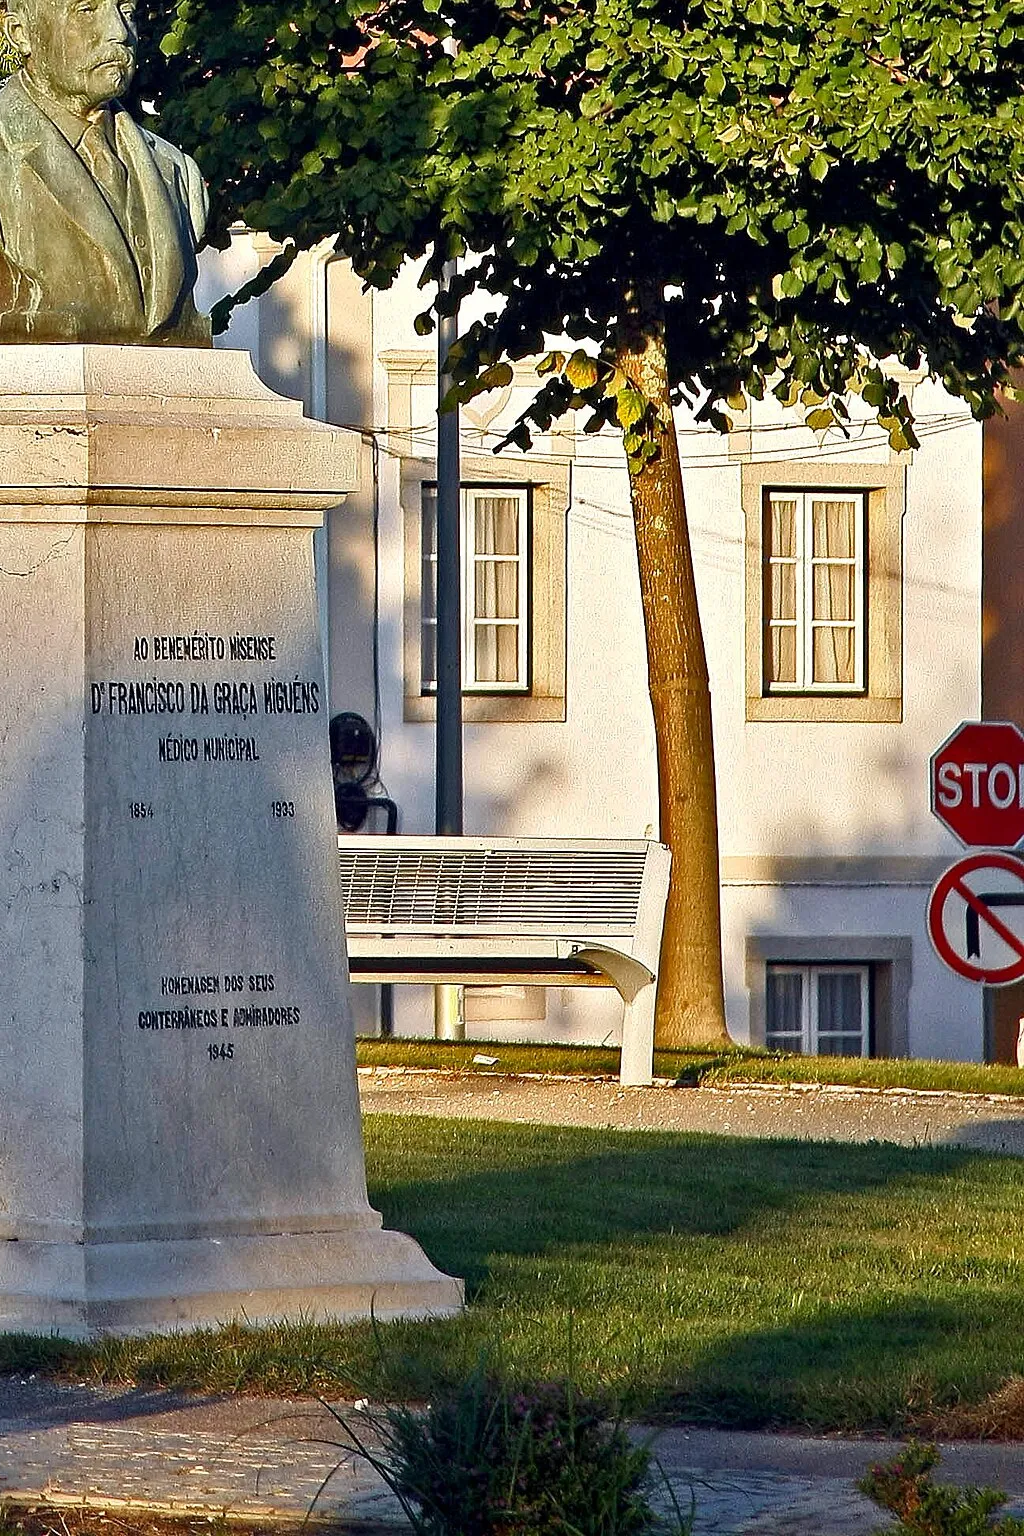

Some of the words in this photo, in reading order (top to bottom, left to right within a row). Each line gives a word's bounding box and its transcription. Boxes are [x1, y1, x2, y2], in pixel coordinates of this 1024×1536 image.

[133, 636, 149, 661] AO
[108, 676, 185, 715] FRANCISCO
[190, 682, 209, 715] DA
[213, 682, 258, 721] GRAÇA
[938, 761, 1024, 809] STO
[128, 801, 154, 819] 1854
[270, 800, 296, 819] 1933
[224, 975, 244, 993] DOS
[248, 974, 275, 993] SEUS
[220, 1008, 229, 1028] E
[206, 1042, 235, 1062] 1945
